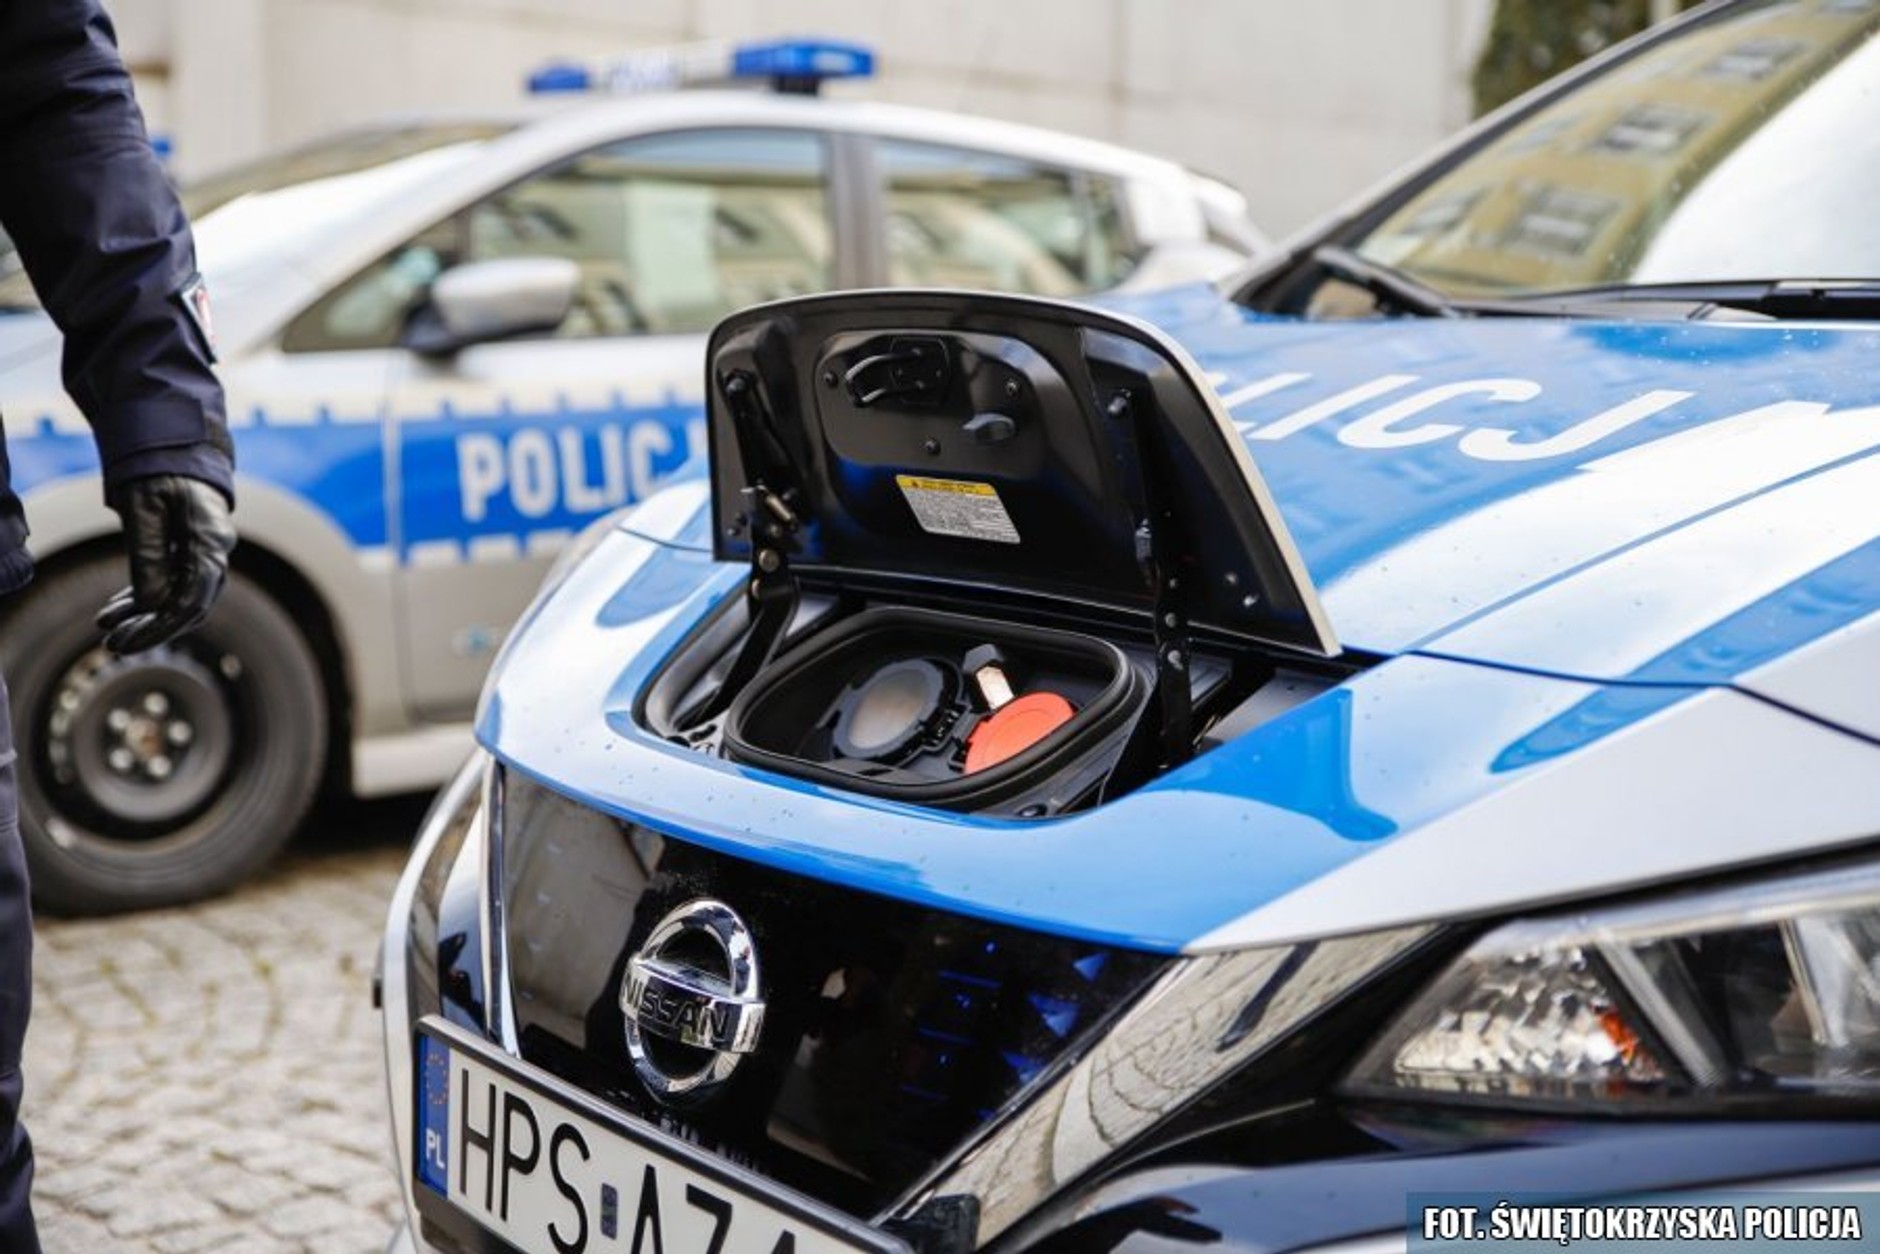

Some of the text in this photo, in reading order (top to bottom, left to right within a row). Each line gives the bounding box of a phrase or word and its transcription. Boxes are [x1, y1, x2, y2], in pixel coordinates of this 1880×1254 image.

[456, 417, 708, 522] POLIC
[621, 970, 730, 1043] NISSAN
[425, 1128, 445, 1170] PL
[460, 1068, 795, 1254] HPS A7
